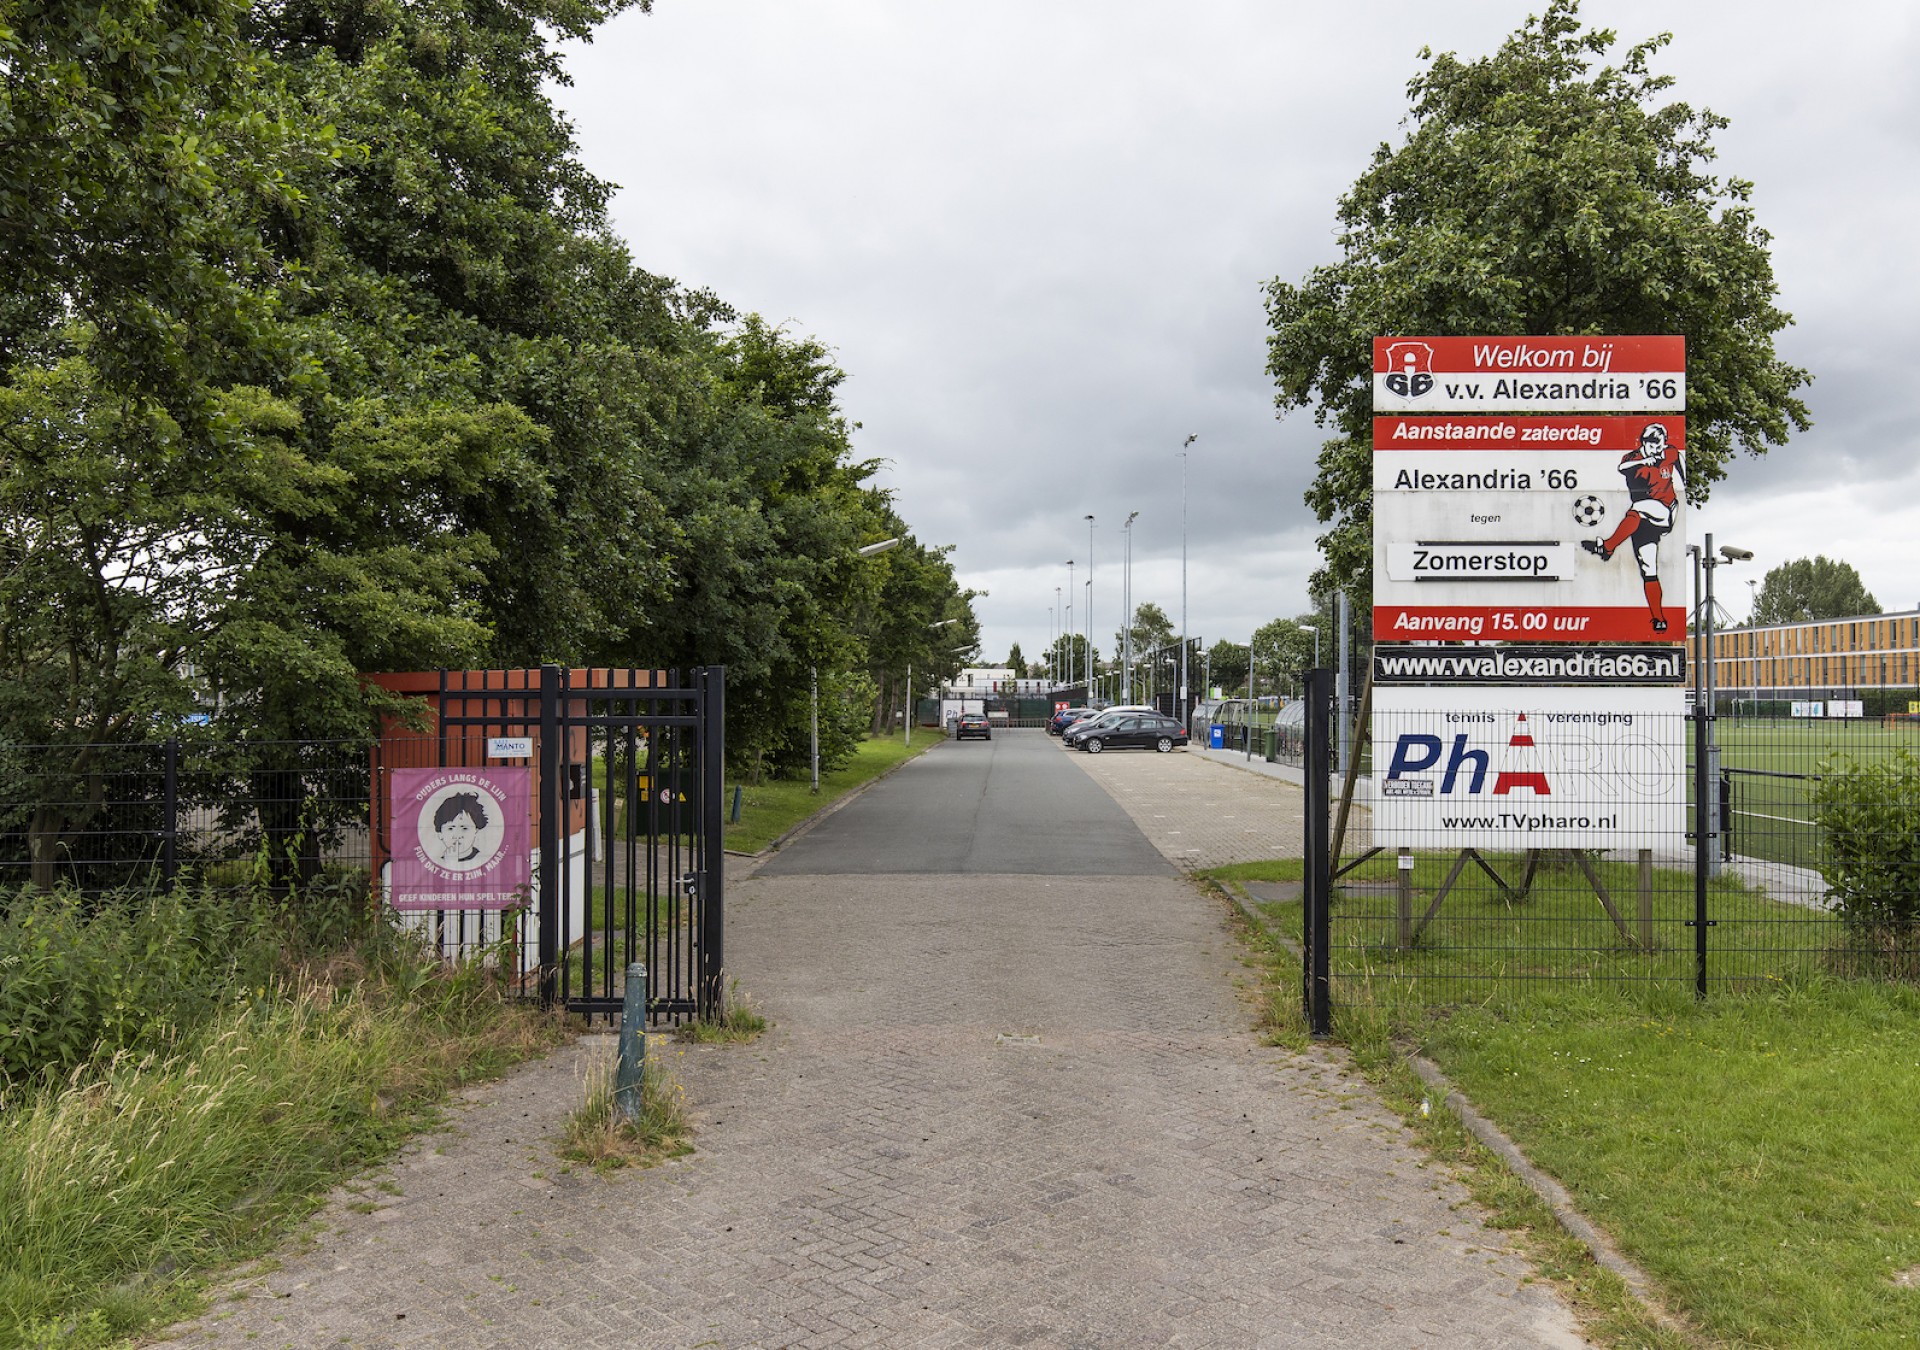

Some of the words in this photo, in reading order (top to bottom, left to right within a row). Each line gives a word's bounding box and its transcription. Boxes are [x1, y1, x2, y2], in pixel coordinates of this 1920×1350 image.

[1473, 344, 1574, 367] Welkom
[1581, 343, 1614, 373] bij
[1445, 383, 1484, 400] v.v.
[1493, 379, 1630, 400] Alexandria
[1392, 421, 1516, 440] Aanstaande
[1521, 423, 1602, 445] zaterdag
[1394, 469, 1531, 490] Alexandria
[1470, 513, 1501, 525] tegen
[1413, 551, 1548, 575] Zomerstop
[1393, 612, 1484, 634] Aanvang
[1553, 615, 1590, 630] uur
[1381, 654, 1680, 677] www.vvalexandria66.nl
[1445, 712, 1496, 723] tennis
[1547, 712, 1633, 726] vereniging
[416, 777, 446, 801] OUDERS
[448, 774, 476, 783] LANGS
[478, 777, 491, 789] DE
[490, 785, 507, 802] LIJN
[1442, 814, 1617, 831] www.TVpharo.nl
[424, 861, 440, 875] DAT
[439, 870, 451, 880] ZE
[452, 873, 463, 881] ER
[399, 893, 417, 902] GEEF
[419, 893, 456, 902] KINDEREN
[458, 893, 475, 901] HUN
[476, 893, 495, 901] SPEL
